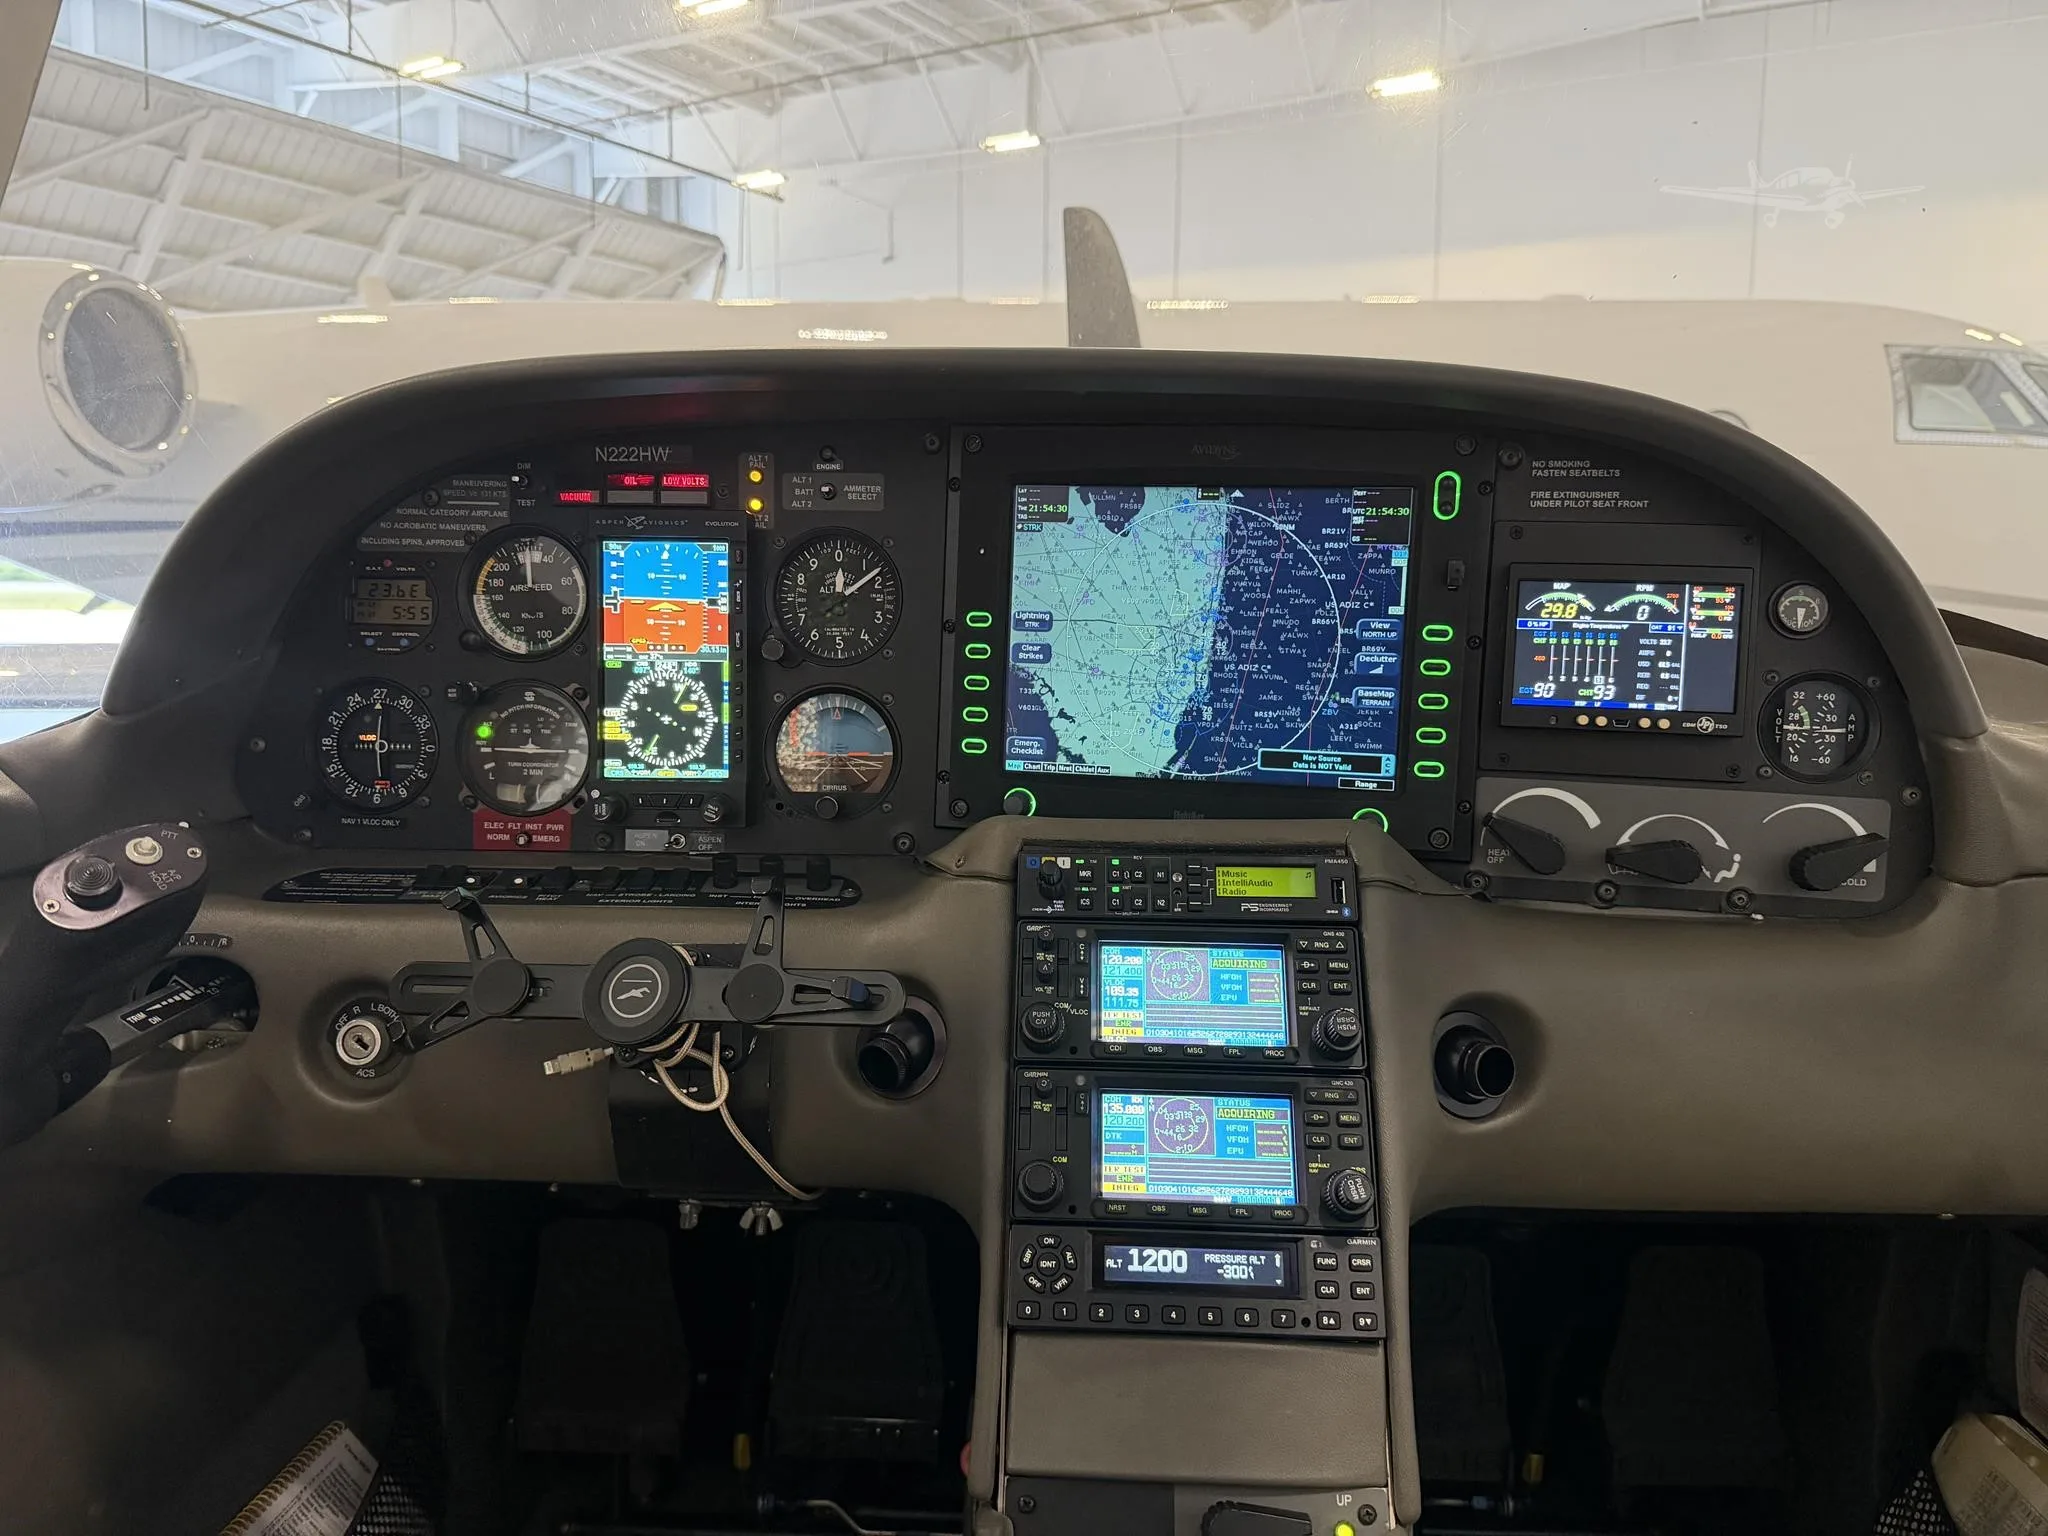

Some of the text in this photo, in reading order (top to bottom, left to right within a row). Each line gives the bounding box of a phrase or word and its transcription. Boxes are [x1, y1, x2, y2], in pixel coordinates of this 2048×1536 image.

[595, 446, 670, 462] N222HW
[1532, 460, 1590, 468] NO SMOKING
[1531, 469, 1620, 477] FASTEN SEATBELTS
[624, 475, 638, 485] OIL
[663, 476, 705, 486] LOW VOLTS
[794, 488, 815, 496] BATT
[843, 485, 882, 493] AMMETER
[560, 492, 592, 502] VACUUM
[1530, 491, 1620, 499] FIRE EXTINGUISHER
[517, 499, 536, 507] TEST
[791, 500, 807, 508] ALT
[1530, 500, 1649, 508] UNDER PILOT SEAT FRONT
[1028, 504, 1068, 512] 21:54:30
[1365, 507, 1410, 515] 21:54:30
[396, 508, 508, 518] NORMAL CATEGORY AIRPLANE
[380, 521, 392, 529] NO
[393, 522, 437, 530] ACROBATIC
[1023, 523, 1042, 531] STRK
[360, 537, 400, 545] INCLUDING
[426, 538, 465, 547] APPROVED
[542, 555, 554, 563] 40
[493, 563, 510, 572] 200
[488, 578, 505, 587] 180
[560, 577, 573, 585] 60
[561, 606, 573, 615] 80
[1541, 603, 1579, 619] 29.8
[1015, 612, 1050, 621] Lightning
[1370, 621, 1391, 629] View
[536, 630, 553, 639] 100
[1021, 644, 1041, 652] Clear
[1018, 652, 1044, 660] Strikes
[1359, 654, 1397, 663] Declutter
[1358, 689, 1395, 699] BaseMap
[1792, 691, 1805, 699] 32
[1786, 733, 1798, 741] 20
[1014, 739, 1041, 748] Emerg.
[1010, 747, 1044, 755] Checklist
[1302, 754, 1317, 762] Nav
[1789, 754, 1799, 762] 16
[1024, 763, 1041, 771] Chart
[1043, 764, 1057, 772] Trip
[1097, 766, 1110, 774] Aux
[1292, 761, 1309, 769] Data
[1317, 762, 1337, 770] NOT
[1337, 763, 1352, 771] Valid
[821, 784, 848, 792] CIRRUS
[1355, 780, 1378, 789] Range
[507, 822, 522, 830] FLT
[546, 823, 564, 831] PWR
[160, 829, 179, 840] PTT
[486, 833, 510, 841] NORM
[532, 834, 560, 842] EMERG
[1486, 856, 1505, 864] OFF
[1221, 869, 1248, 878] Music
[148, 870, 168, 891] HOLD
[1221, 878, 1273, 887] IntelliAudio
[1222, 887, 1247, 896] Radio
[1212, 959, 1268, 968] ACQUIRING
[1104, 965, 1142, 975] 121.400
[126, 1011, 147, 1024] TRIM
[377, 1004, 401, 1023] BOTH
[148, 1015, 162, 1025] DN
[335, 1013, 350, 1031] OFF
[1265, 1049, 1285, 1057] PROC
[1217, 1109, 1275, 1119] ACQUIRING
[1104, 1115, 1145, 1126] 120.200
[1274, 1209, 1292, 1217] PROC
[1043, 1237, 1055, 1245] ON
[1346, 1238, 1377, 1246] GARMIN
[1023, 1249, 1033, 1263] SBY
[1065, 1251, 1074, 1264] ALT
[1128, 1248, 1188, 1273] 1200
[1204, 1253, 1266, 1265] PRESSURE ALT
[1040, 1260, 1056, 1268] IDNT
[1105, 1258, 1123, 1269] ALT
[1316, 1257, 1336, 1265] FUNC
[1351, 1258, 1371, 1266] CRSR
[1028, 1276, 1042, 1288] OFF
[1054, 1278, 1068, 1290] VFR
[1320, 1286, 1335, 1294] CLR
[1356, 1287, 1370, 1295] ENT
[1336, 1495, 1352, 1506] UP
